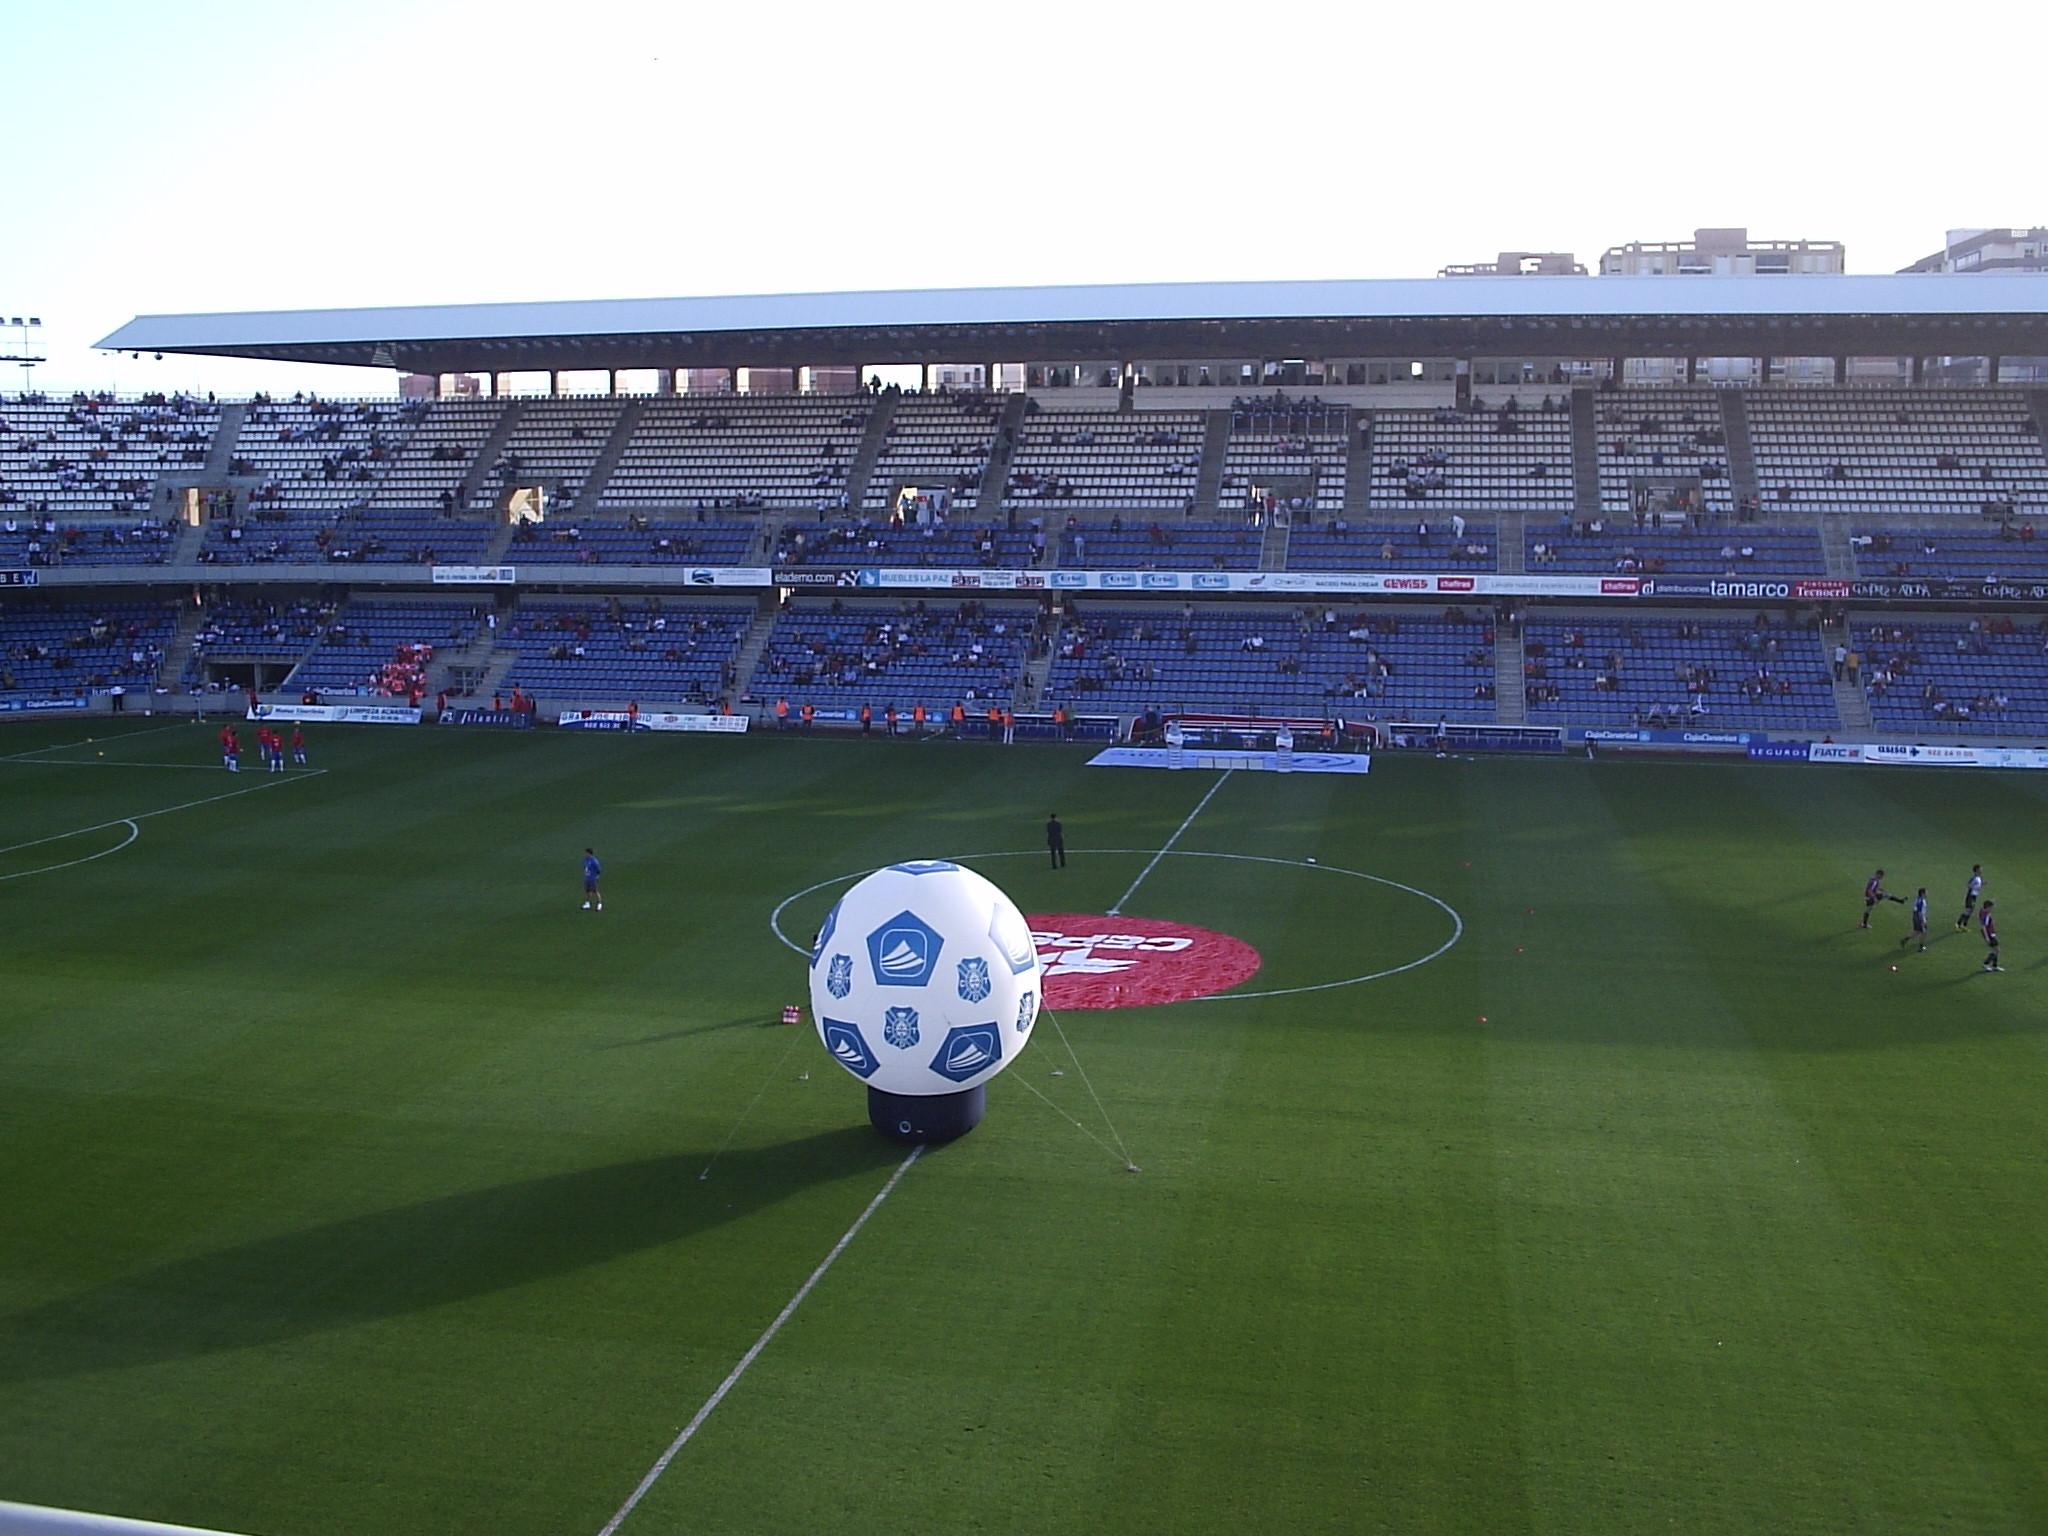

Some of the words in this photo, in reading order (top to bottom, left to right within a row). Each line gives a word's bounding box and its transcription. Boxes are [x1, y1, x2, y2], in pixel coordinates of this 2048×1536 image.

[1383, 578, 1429, 589] GEWISS
[1711, 580, 1789, 596] tamarco
[1796, 586, 1849, 597] Tecnocril
[1750, 748, 1808, 757] SEGUROS
[1814, 748, 1846, 757] FIATC
